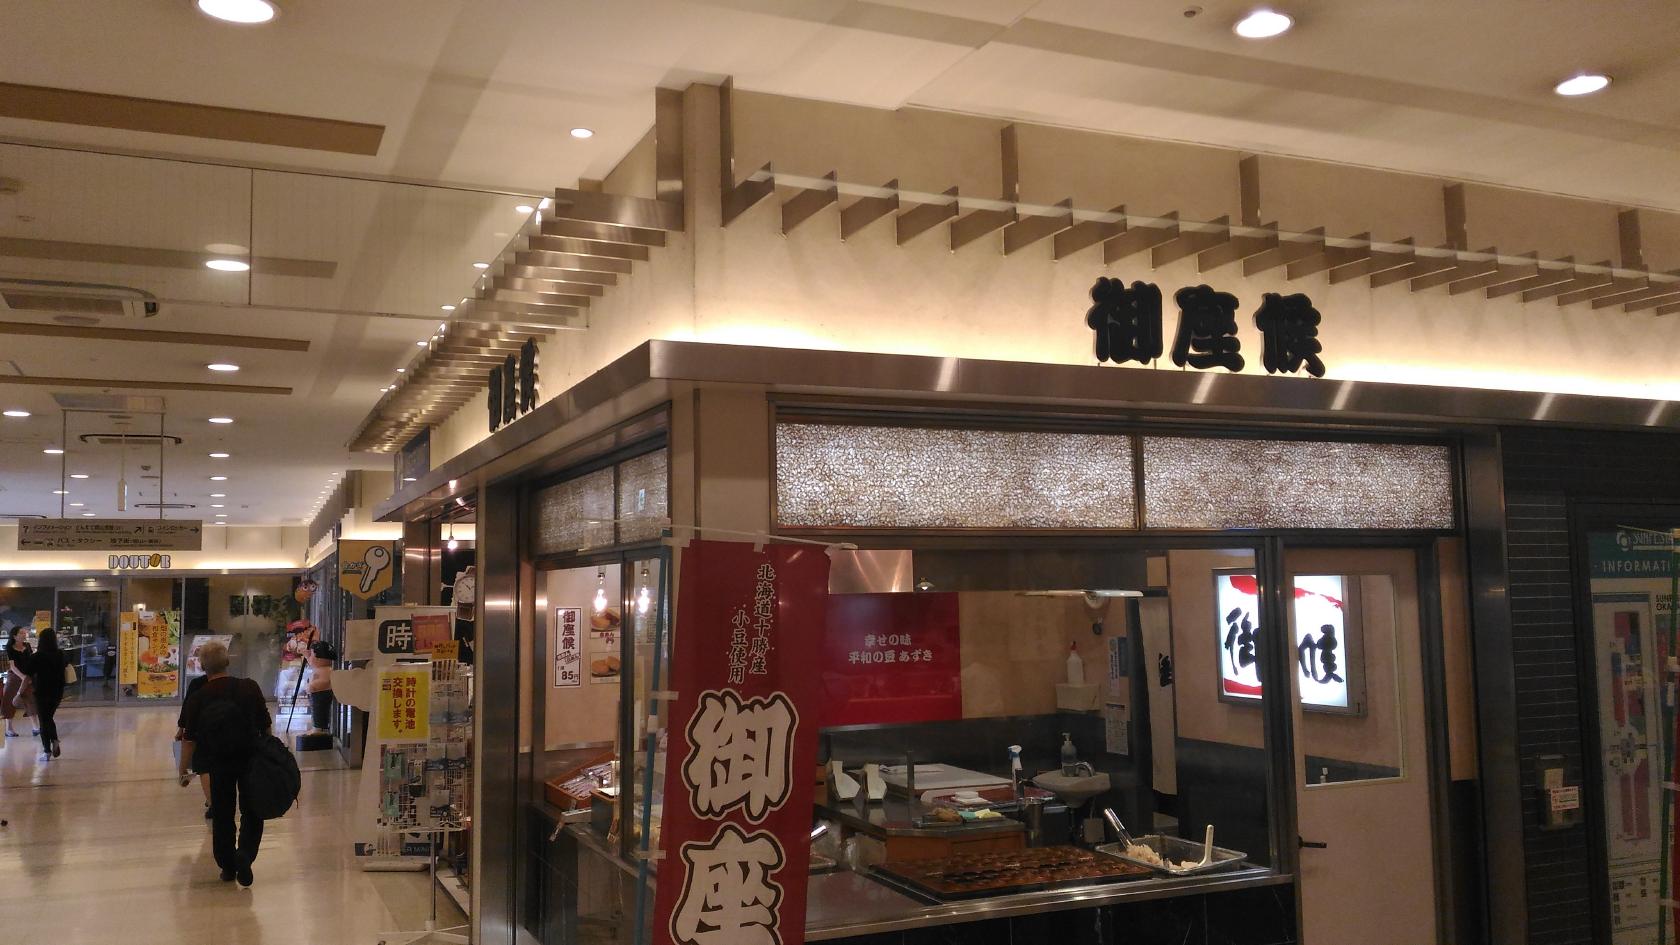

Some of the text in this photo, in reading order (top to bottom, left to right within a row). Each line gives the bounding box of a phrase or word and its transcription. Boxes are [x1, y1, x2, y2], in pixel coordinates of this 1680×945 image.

[108, 553, 171, 569] DOUTOR
[1602, 560, 1671, 573] INFORMATI
[749, 563, 775, 675] 北海道十勝産
[562, 610, 576, 650] 御座候
[728, 609, 750, 684] 小豆使用
[864, 633, 912, 647] 幸せの味
[848, 647, 933, 664] 平和の豆 あずき
